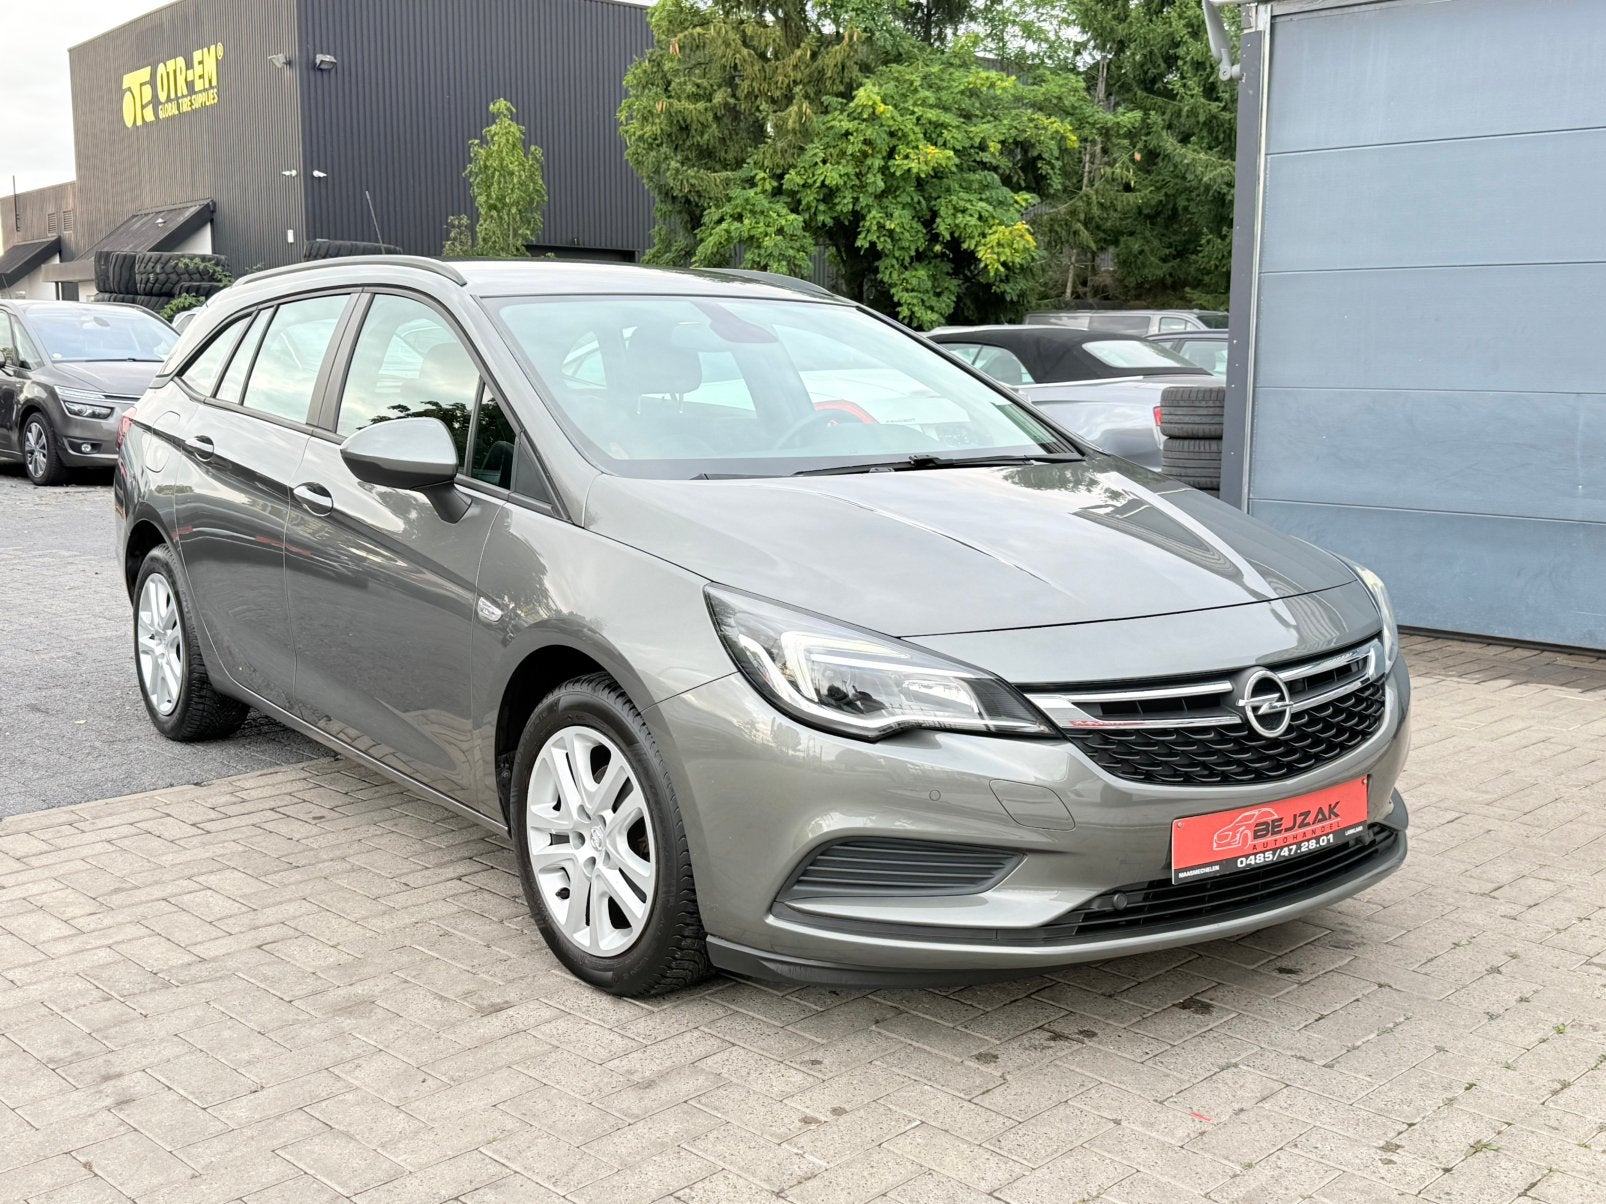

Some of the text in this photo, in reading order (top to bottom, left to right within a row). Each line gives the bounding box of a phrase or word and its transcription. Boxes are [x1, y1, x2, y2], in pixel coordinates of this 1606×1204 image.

[159, 88, 218, 119] GLOBAL TIRE SUPPLIES
[1252, 822, 1341, 851] AUTOHANDEL
[1253, 801, 1341, 839] BEJZAK
[1237, 833, 1334, 868] 0485/47.28.01
